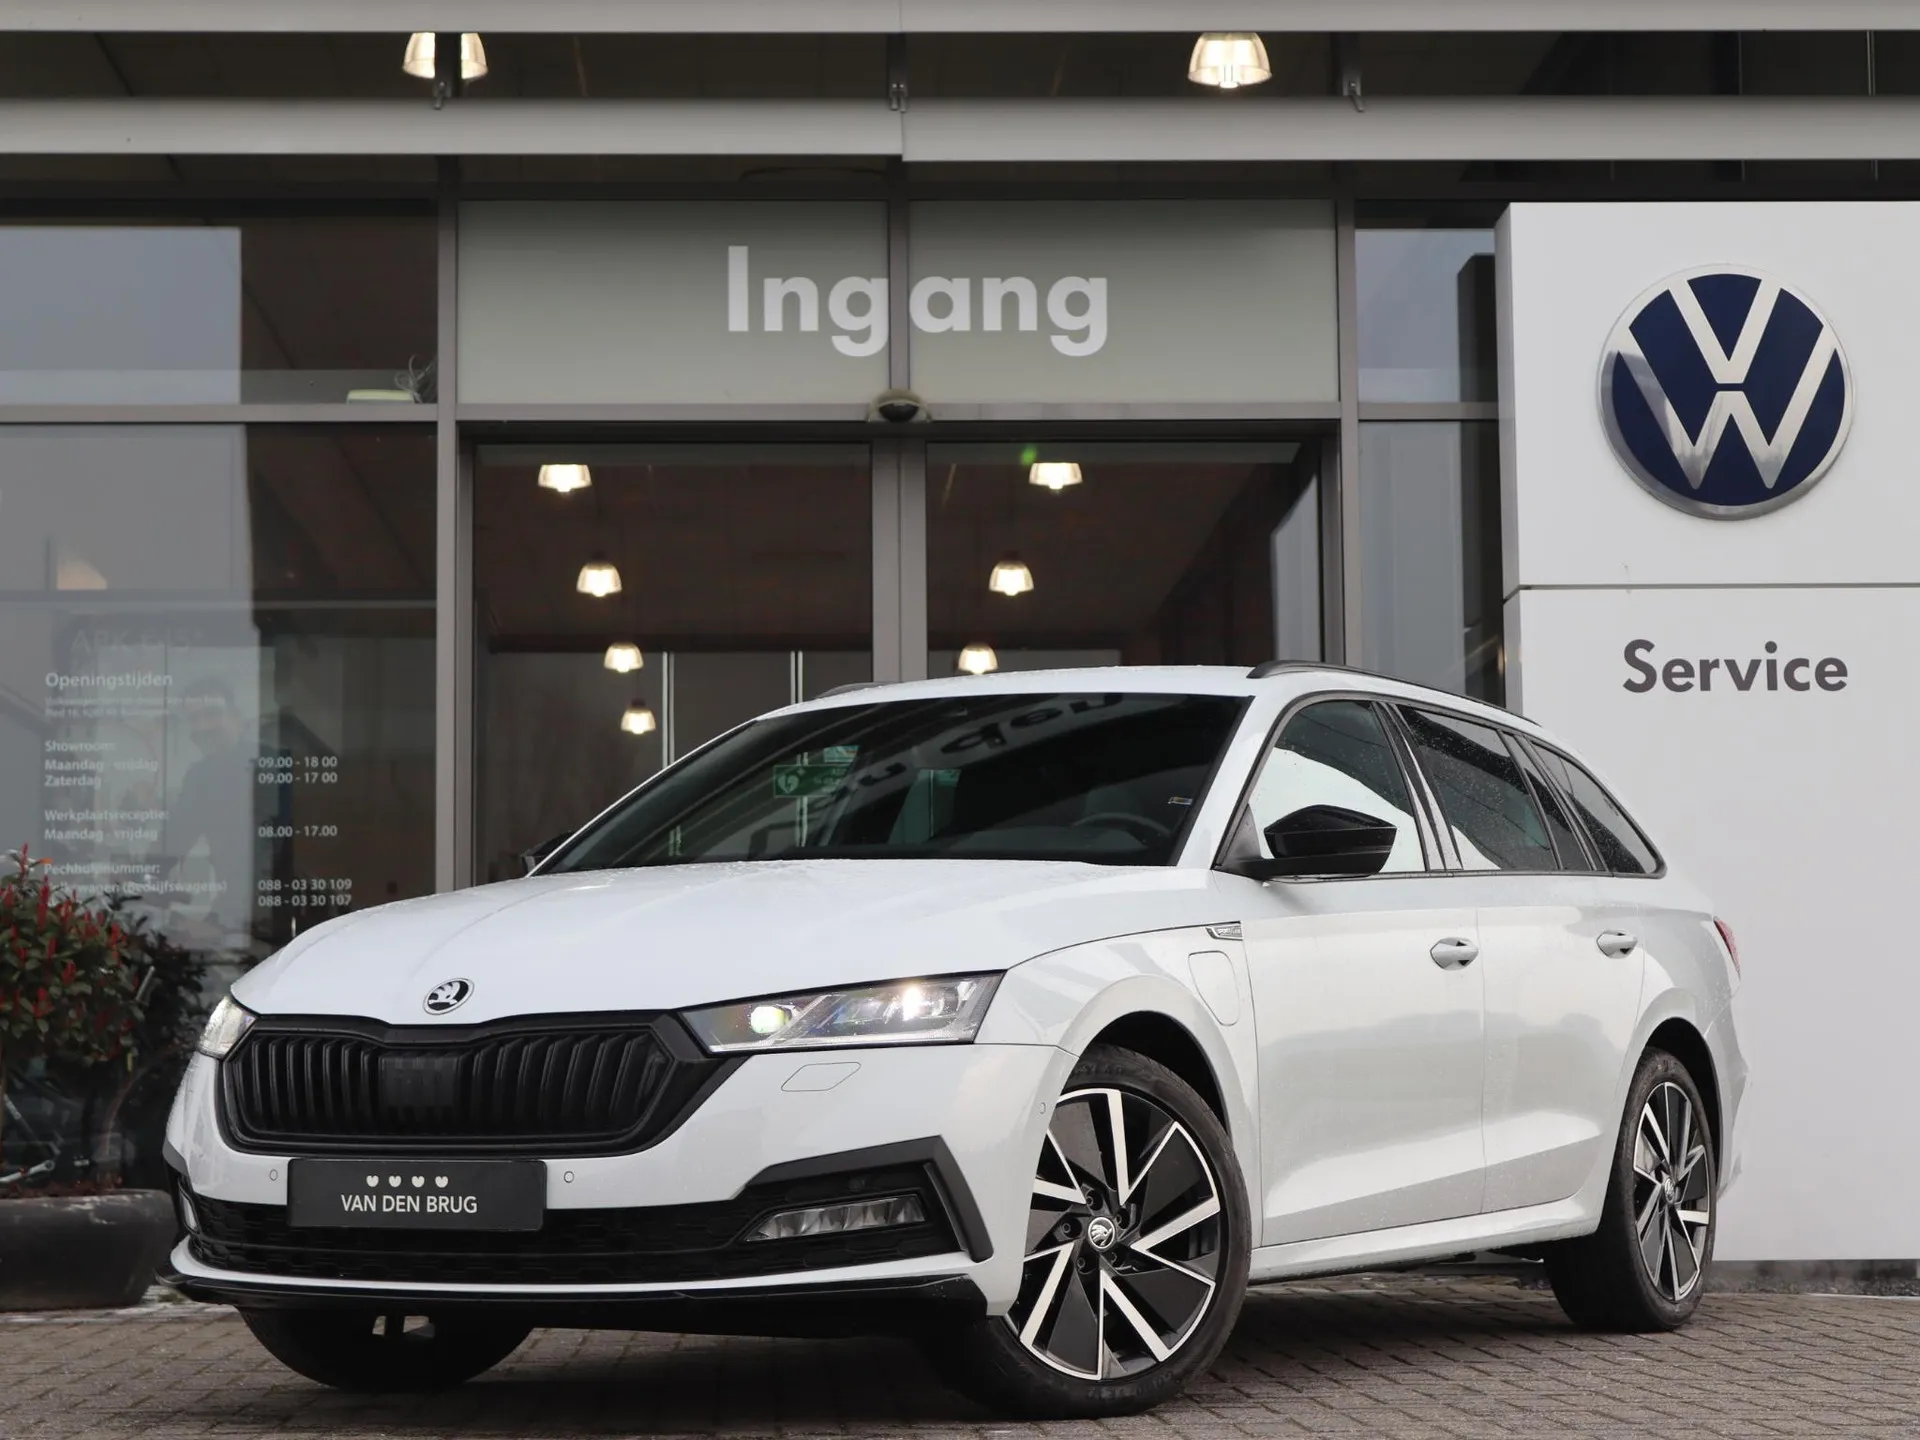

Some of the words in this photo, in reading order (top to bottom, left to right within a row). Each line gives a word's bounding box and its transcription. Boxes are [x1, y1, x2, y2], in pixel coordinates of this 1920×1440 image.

[728, 246, 1108, 357] Ingang
[1623, 638, 1848, 693] Service
[45, 670, 173, 690] Openingstijden
[44, 758, 104, 772] Maandag
[258, 756, 293, 768] 09.00
[44, 775, 102, 788] Zaterdag
[258, 772, 293, 784] 09.00
[44, 828, 104, 842] Maandag
[114, 827, 158, 842] vrijdag
[258, 825, 293, 838] 08.00
[304, 825, 338, 837] 17.00
[258, 879, 282, 891] 088
[291, 879, 307, 891] 03
[311, 879, 326, 891] 30
[330, 878, 352, 891] 109
[258, 895, 282, 907] 088
[291, 895, 307, 907] 03
[311, 895, 326, 907] 30
[330, 894, 352, 906] 107
[341, 1194, 376, 1212] VAN
[382, 1195, 420, 1213] DEN
[426, 1195, 478, 1214] BRUG
